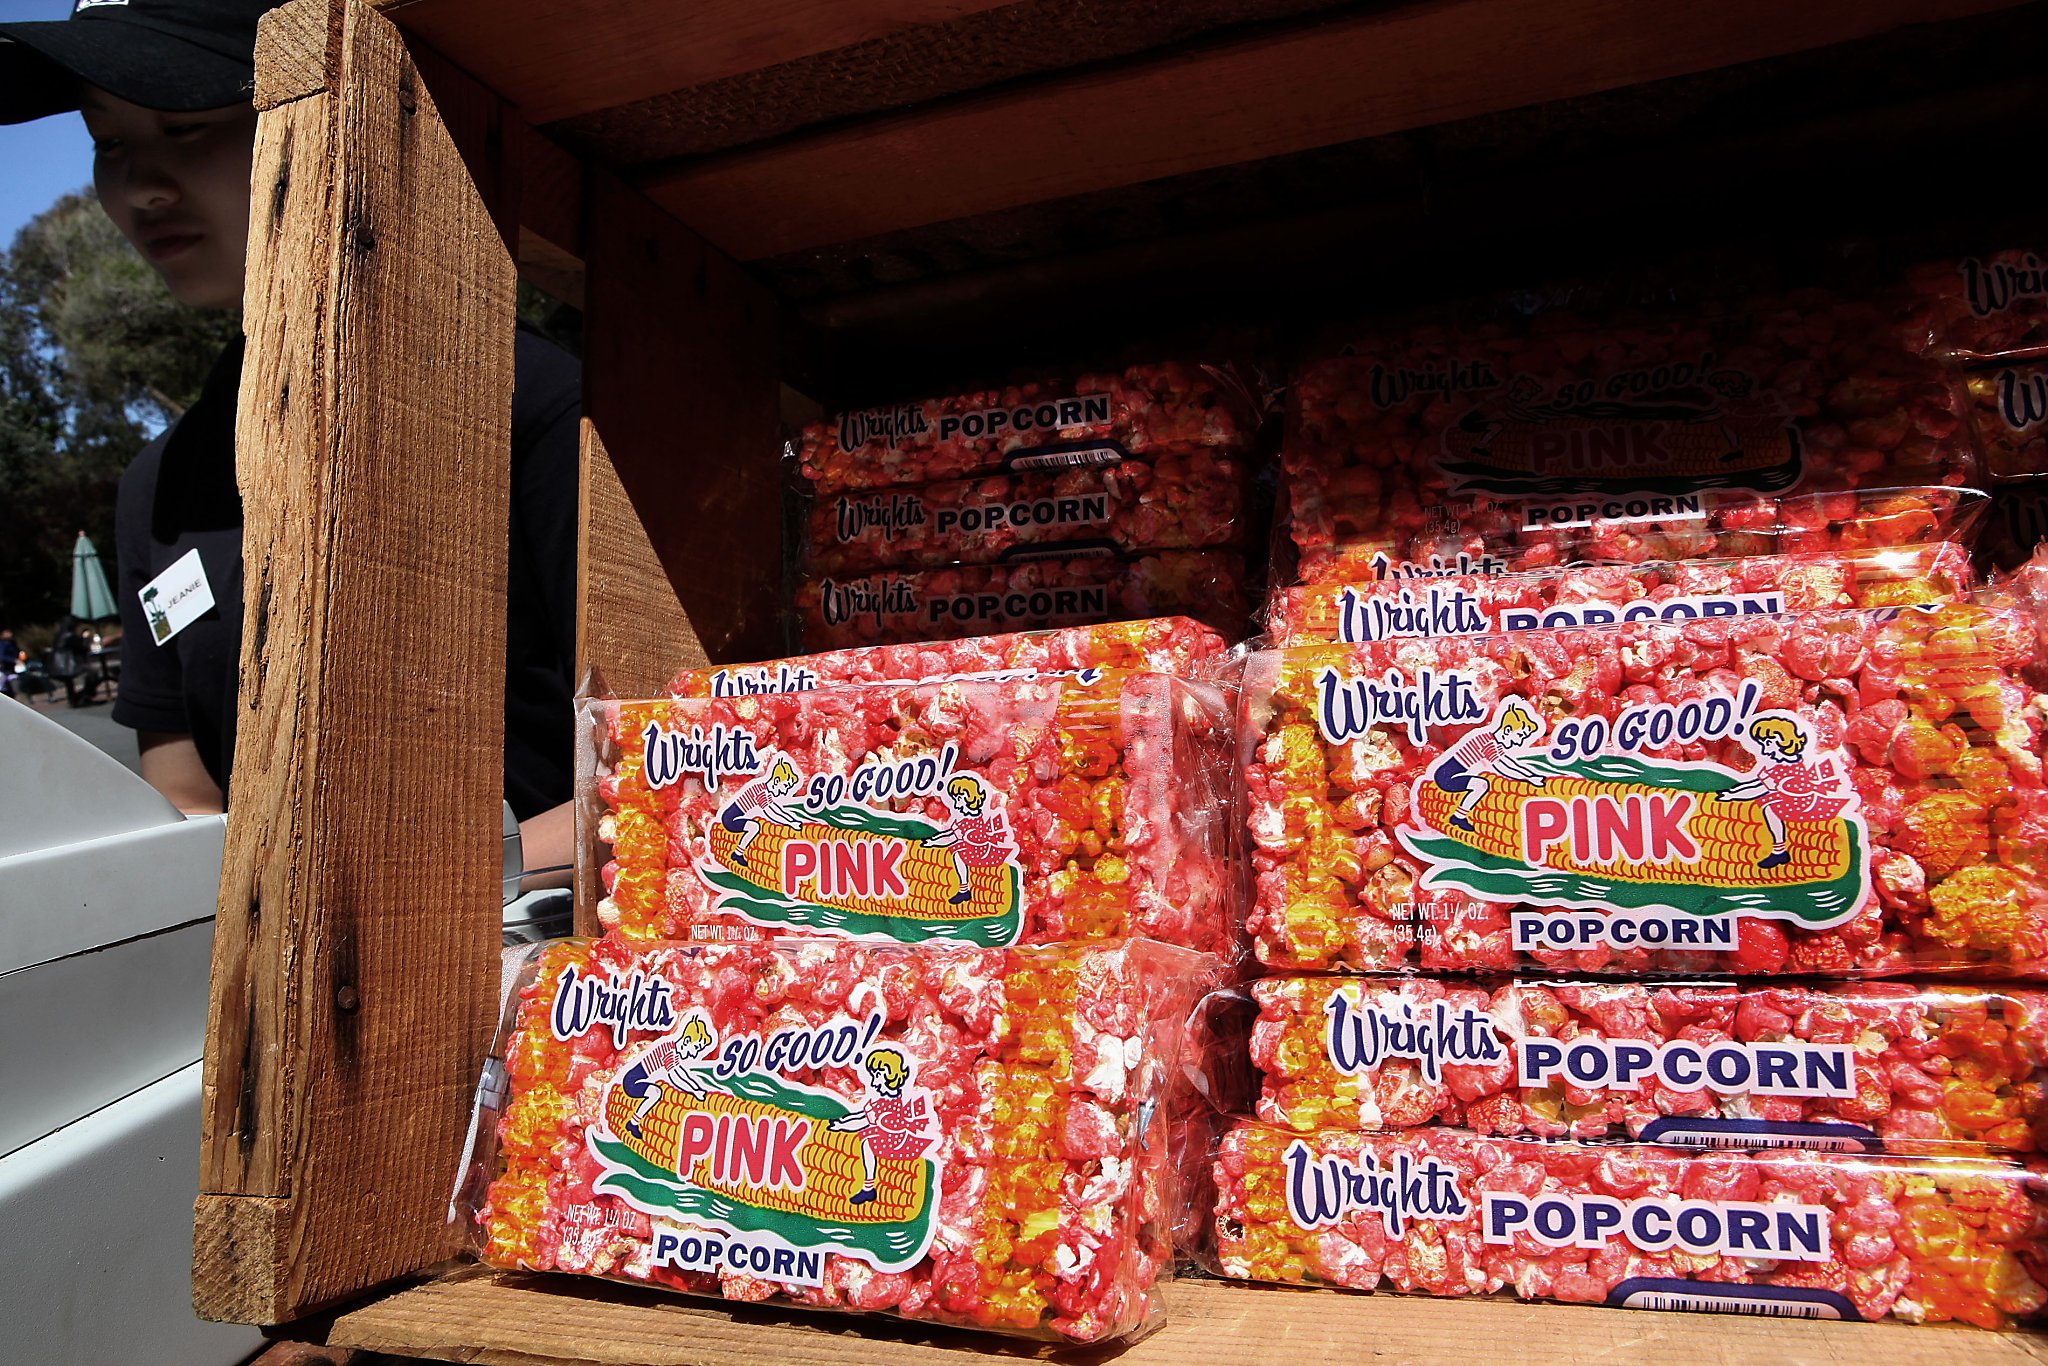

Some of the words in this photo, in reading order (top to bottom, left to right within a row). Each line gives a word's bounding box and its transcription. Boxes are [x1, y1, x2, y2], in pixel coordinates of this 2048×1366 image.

[1370, 359, 1499, 407] Wrights
[1553, 383, 1595, 407] SO
[1606, 352, 1713, 397] GOOD!
[838, 404, 928, 452] Wrights
[941, 400, 1108, 438] POPCORN
[1533, 422, 1669, 474] PINK
[837, 496, 926, 541] Wrights
[938, 497, 1106, 532] POPCORN
[1527, 496, 1700, 527] POPCORN
[167, 579, 202, 609] JEANIE
[822, 580, 918, 626] Wrights
[931, 589, 1104, 621] POPCORN
[1340, 588, 1486, 641] Wrights
[1318, 670, 1484, 742] Wrights
[1551, 722, 1600, 760] SO
[1621, 684, 1757, 747] GOOD!
[645, 724, 760, 785] Wrights
[807, 776, 845, 808] SO
[856, 748, 954, 799] GOOD!
[1525, 796, 1696, 863] PINK
[785, 842, 905, 899] PINK
[691, 924, 708, 940] NET
[1392, 903, 1415, 920] NET
[1418, 903, 1439, 920] WT.
[1468, 903, 1489, 920] OZ.
[1393, 924, 1437, 945] (35.4g)
[1519, 919, 1730, 944] POPCORN
[555, 967, 673, 1047] Wrights
[717, 1040, 762, 1077] SO
[767, 1014, 881, 1071] GOOD!
[1327, 990, 1502, 1083] Wrights
[1526, 1043, 1851, 1094] POPCORN
[680, 1114, 808, 1187] PINK
[1286, 1143, 1468, 1238] Wrights
[1490, 1198, 1822, 1253] POPCORN
[657, 1233, 820, 1279] POPCORN
